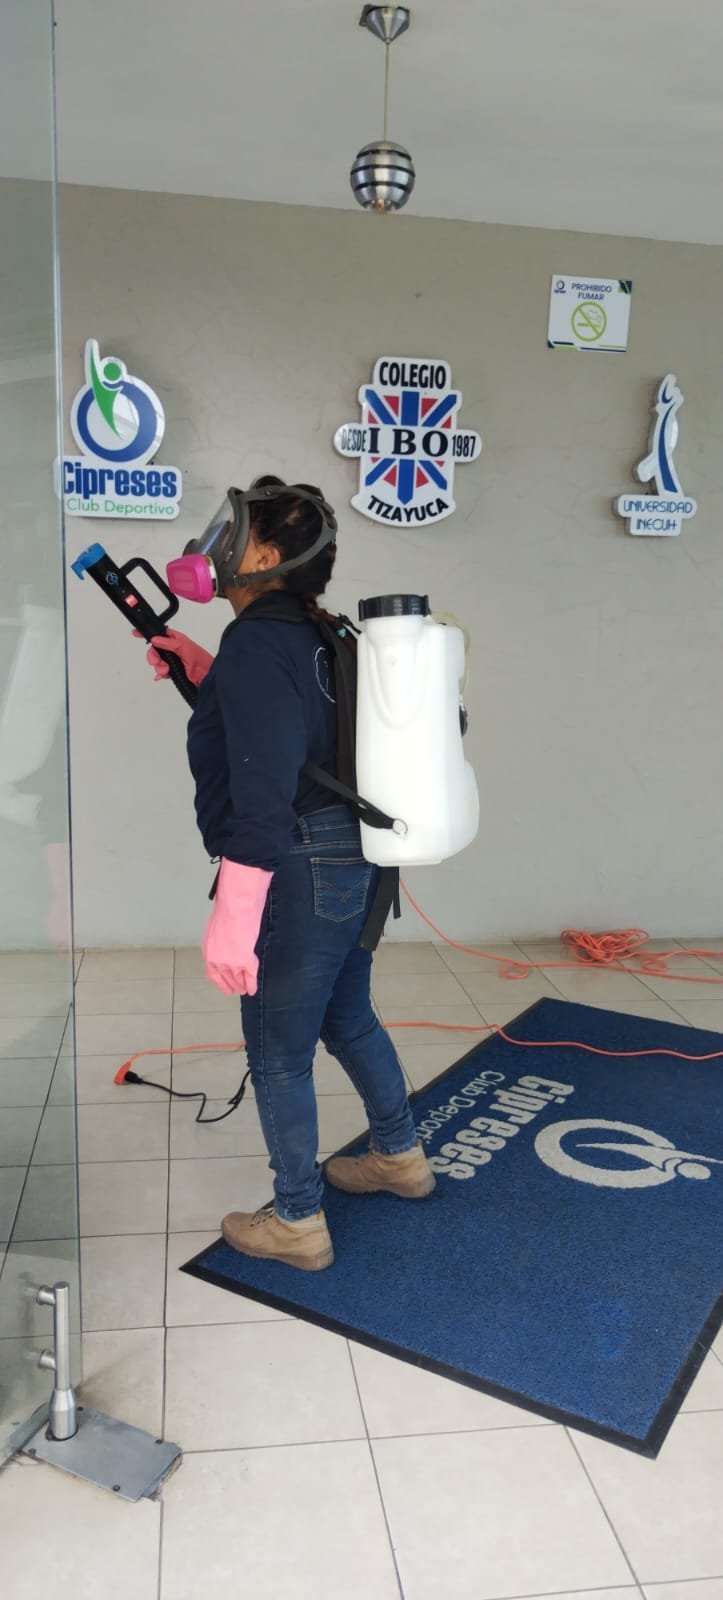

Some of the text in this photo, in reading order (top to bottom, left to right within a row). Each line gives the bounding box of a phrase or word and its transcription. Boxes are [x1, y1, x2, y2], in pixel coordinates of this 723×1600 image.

[571, 283, 612, 293] PROHIBIDO
[578, 292, 604, 300] FUMAR
[379, 361, 446, 389] COLEGIO
[341, 428, 367, 452] DESDE
[452, 435, 476, 457] 1987
[63, 461, 177, 499] Cipreses
[66, 498, 175, 515] Club Deportivo
[367, 495, 449, 522] TIZAYUCA
[624, 500, 693, 513] UNIVERSIDAD
[416, 1070, 506, 1144] Club Deport
[428, 1075, 574, 1180] Cipreses
